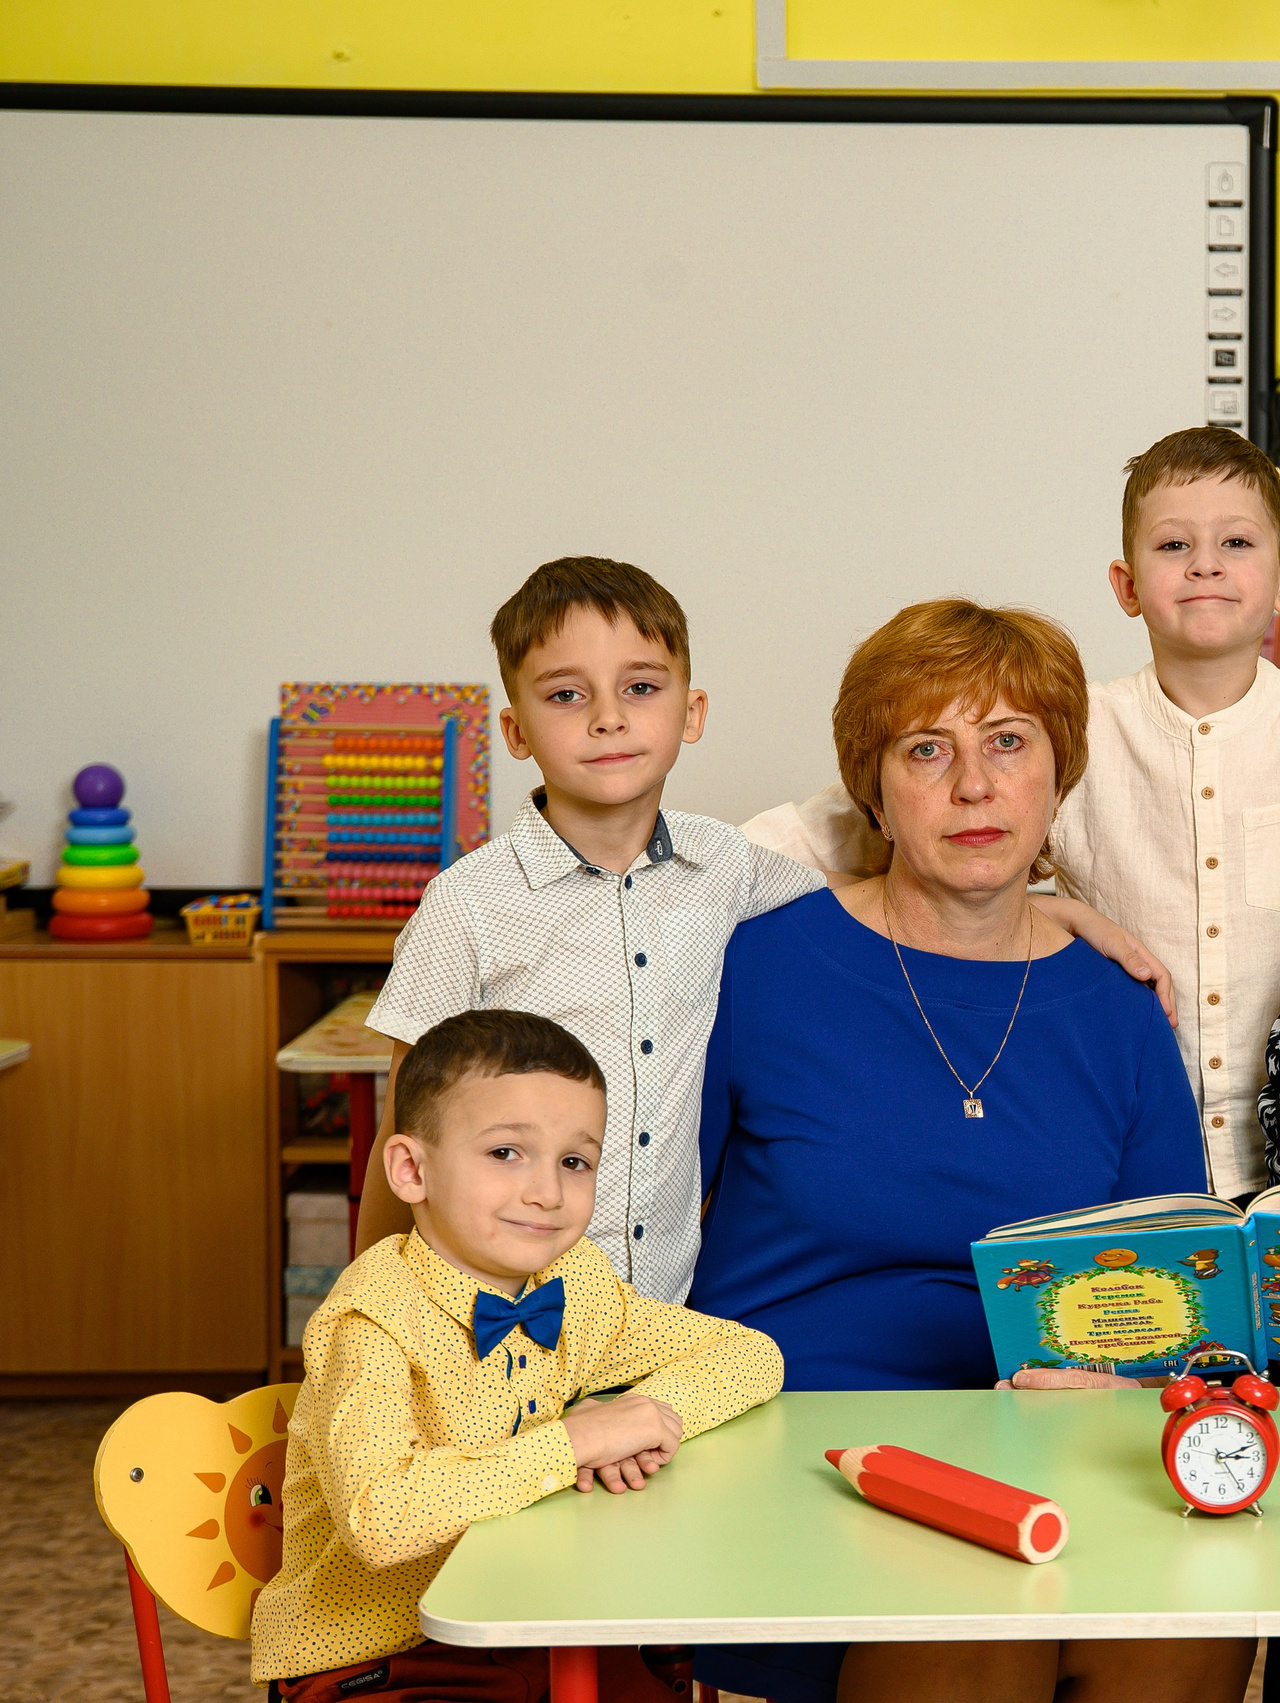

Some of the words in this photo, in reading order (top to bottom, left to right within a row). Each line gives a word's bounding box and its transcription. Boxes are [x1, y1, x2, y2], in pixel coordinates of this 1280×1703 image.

[1091, 1284, 1144, 1292] Колобок
[1093, 1292, 1145, 1300] Теремок
[1077, 1301, 1131, 1310] Курочка
[1091, 1315, 1154, 1323] Машенька
[1069, 1337, 1122, 1346] Петушок
[1199, 1423, 1210, 1434] 11
[1214, 1417, 1228, 1429] 12
[1237, 1423, 1243, 1433] 1
[1188, 1436, 1201, 1447] 10
[1246, 1432, 1254, 1443] 2
[1183, 1452, 1190, 1463] 9
[1253, 1450, 1260, 1462] 3
[1189, 1470, 1197, 1481] 8
[1247, 1467, 1255, 1478] 4
[1202, 1482, 1210, 1494] 7
[1218, 1484, 1226, 1495] 6
